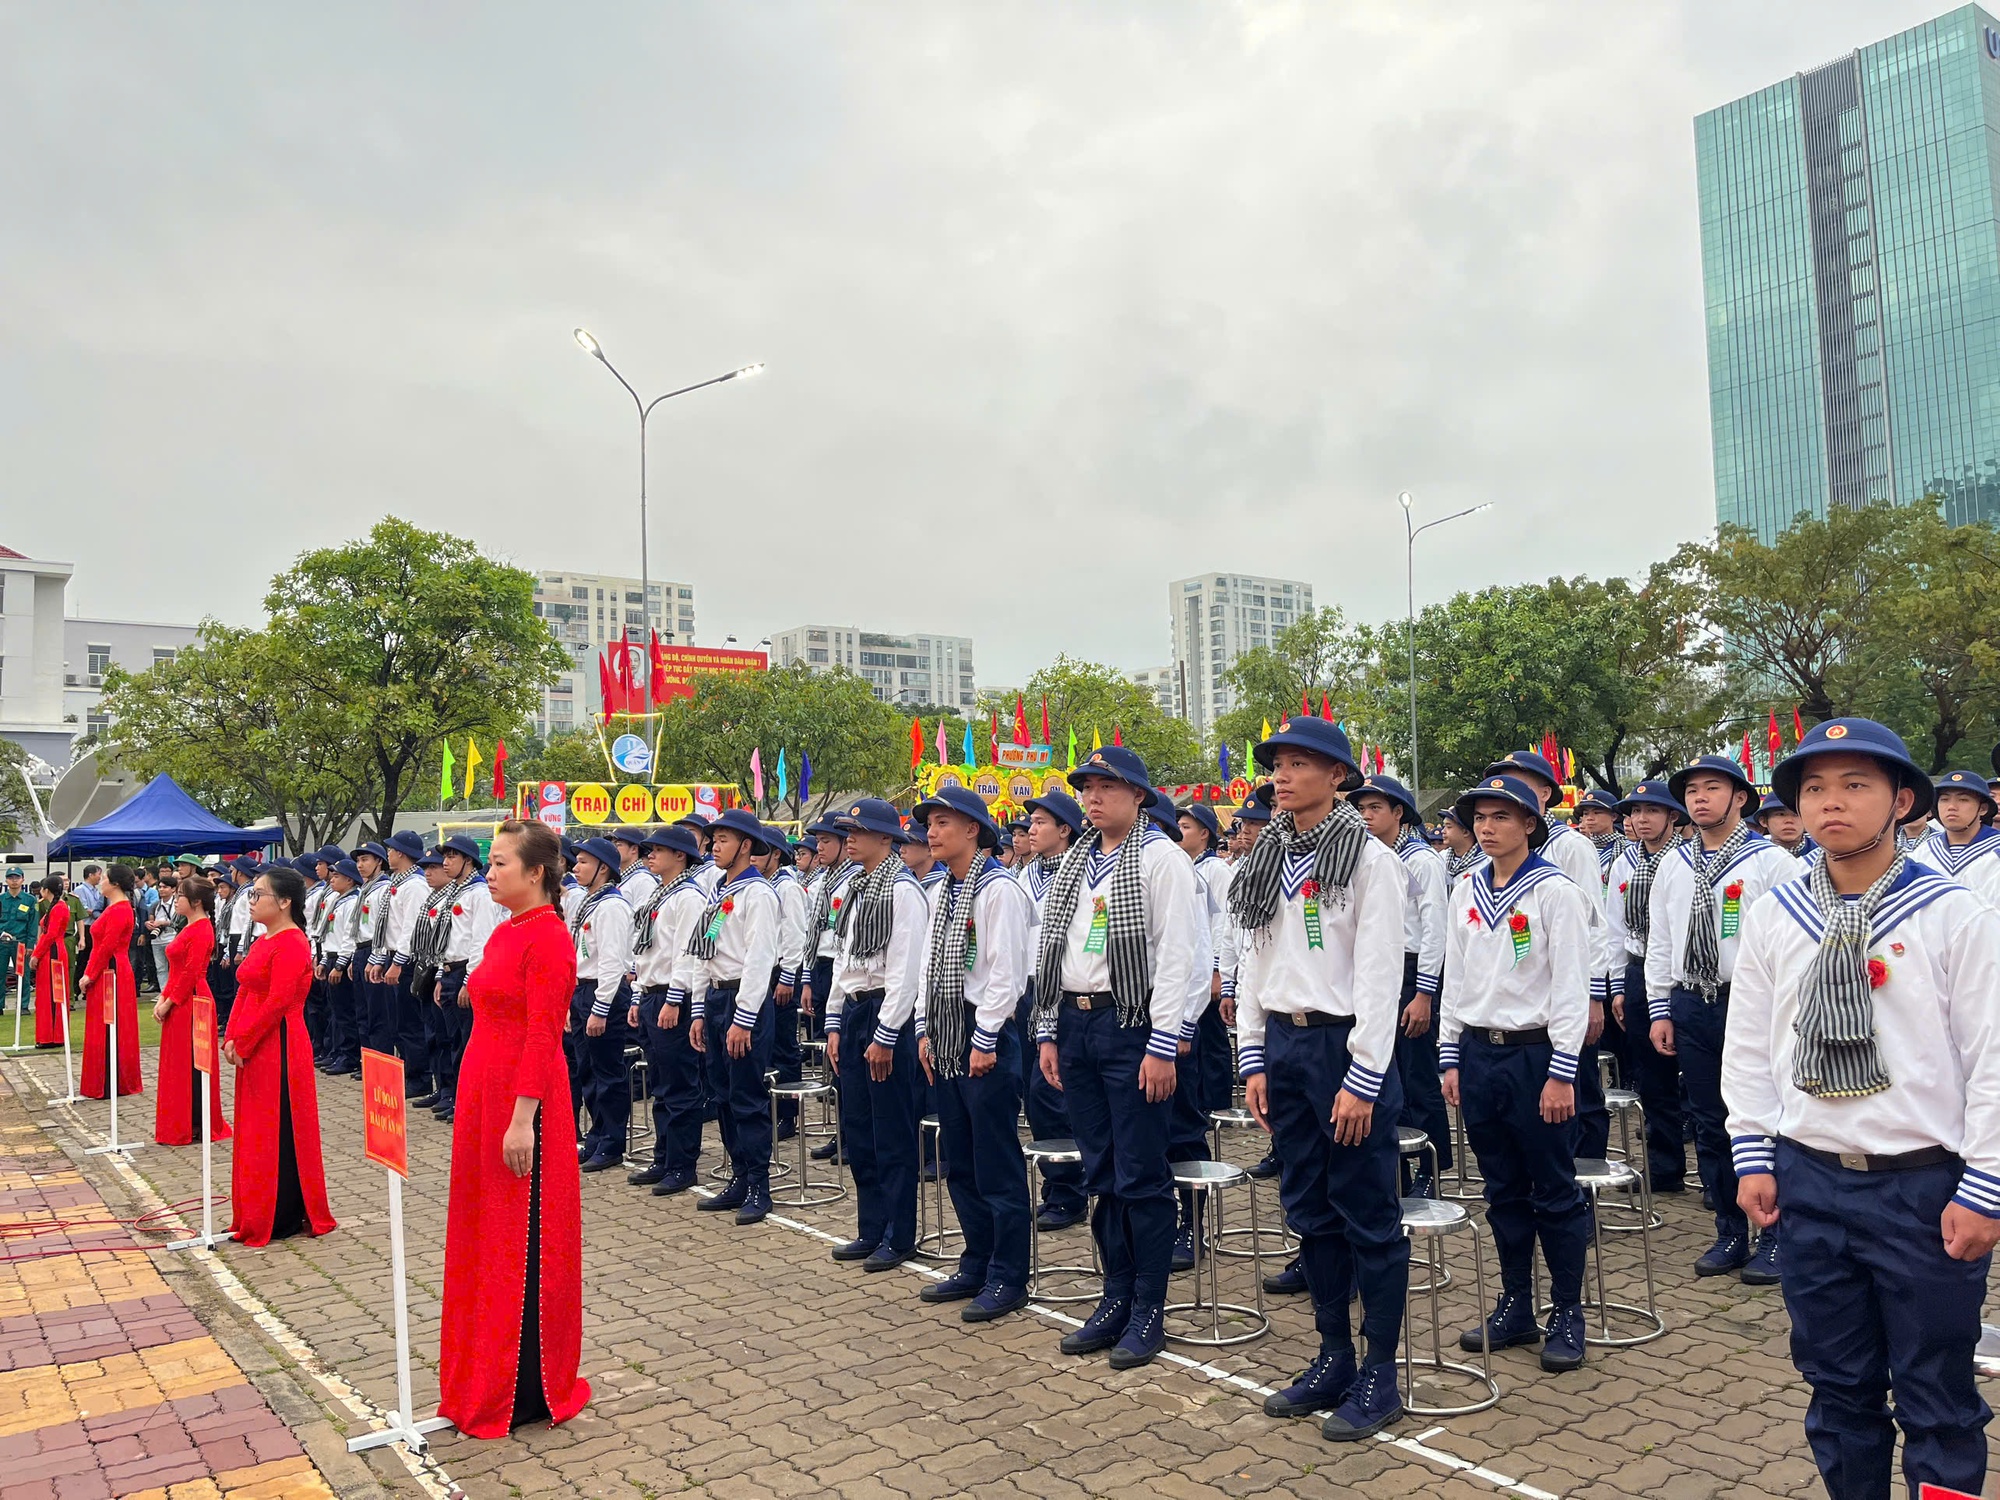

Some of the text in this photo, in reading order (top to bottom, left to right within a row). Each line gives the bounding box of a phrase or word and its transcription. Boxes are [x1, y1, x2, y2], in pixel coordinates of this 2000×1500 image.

[1002, 748, 1024, 761] PHƯỜNG
[1026, 749, 1037, 762] PHÚ
[574, 793, 687, 816] TRẠI CHỈ HUY
